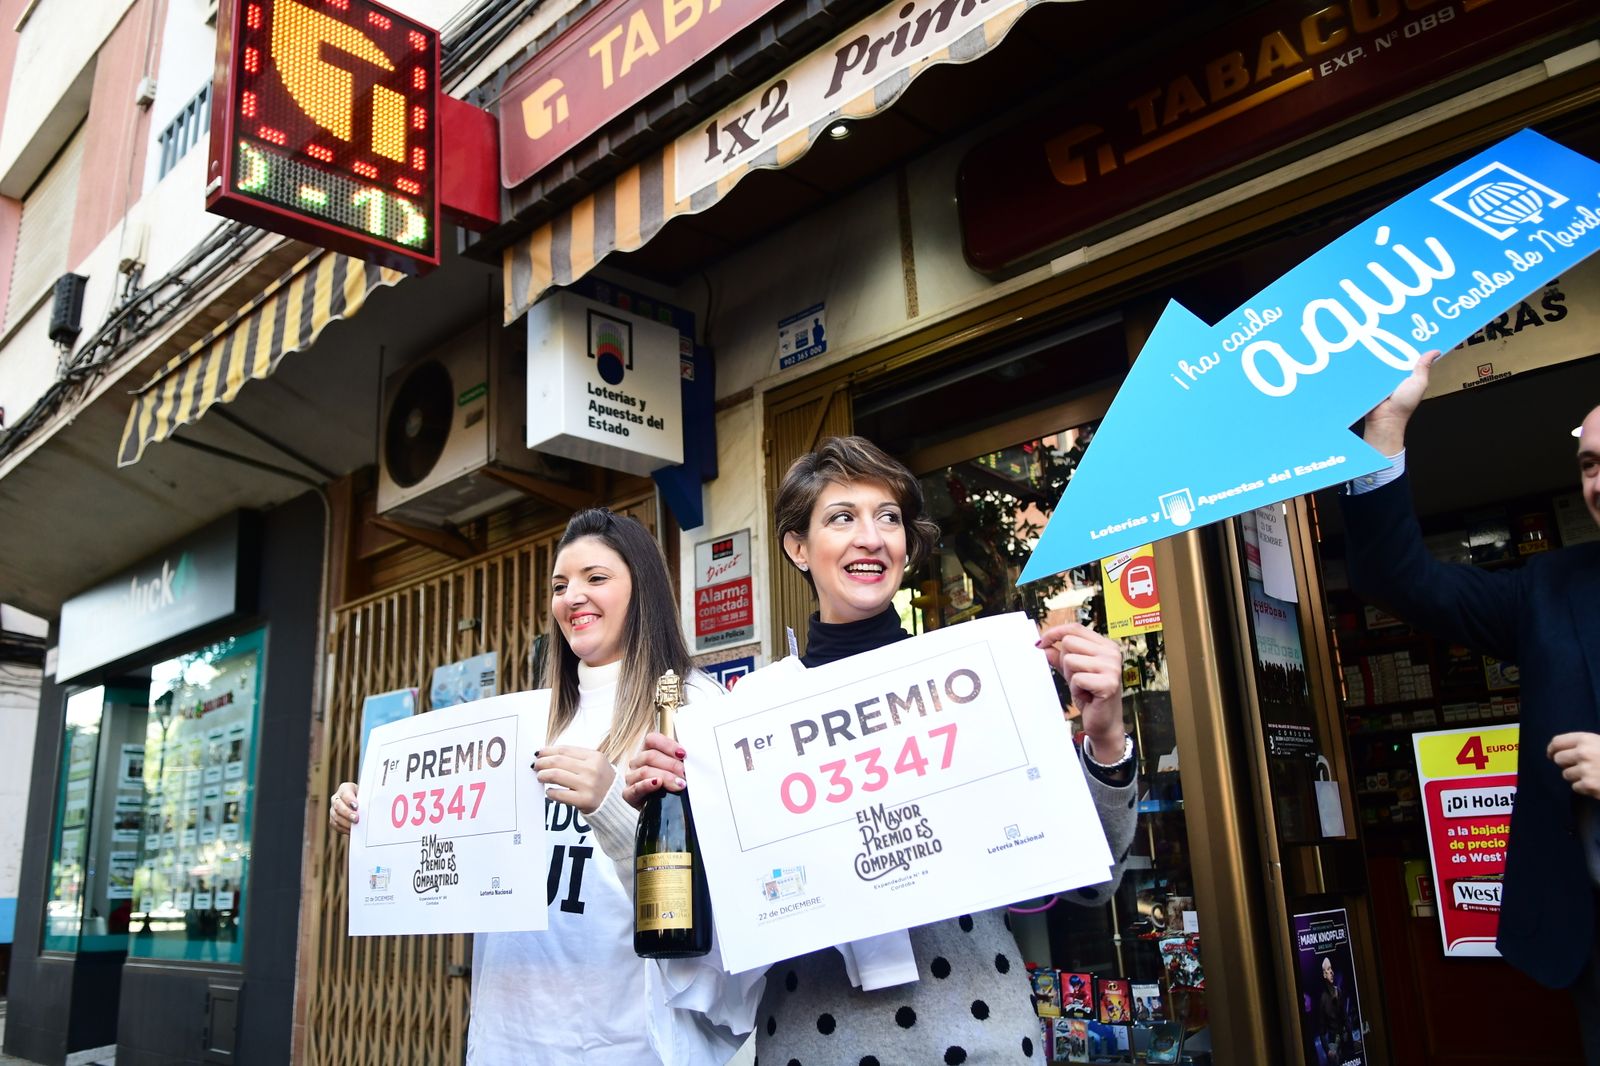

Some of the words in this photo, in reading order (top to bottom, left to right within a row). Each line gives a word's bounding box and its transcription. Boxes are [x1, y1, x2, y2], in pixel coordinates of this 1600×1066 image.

[824, 0, 992, 99] Prim
[1319, 46, 1368, 77] EXP.
[1403, 5, 1456, 39] 089
[1411, 313, 1440, 342] el
[1432, 271, 1515, 319] Gordo
[1504, 249, 1543, 272] de
[1528, 203, 1600, 253] Navid
[1241, 226, 1456, 397] aquí
[1454, 291, 1568, 350] ERAS
[588, 399, 644, 425] Apuestas
[646, 415, 664, 430] del
[639, 399, 646, 412] y
[588, 416, 630, 437] Estado
[1197, 479, 1264, 506] Apuestas
[1268, 469, 1291, 485] del
[1294, 454, 1347, 476] Estado
[1151, 511, 1160, 523] y
[700, 584, 748, 605] Alarma
[699, 596, 749, 618] conectada
[790, 668, 982, 757] PREMIO
[406, 736, 506, 782] PREMIO
[1456, 735, 1489, 770] 4
[1486, 743, 1520, 753] EUROS
[780, 722, 958, 815] 03347
[391, 782, 486, 829] 03347
[1447, 795, 1468, 813] ¡Di
[1472, 792, 1515, 809] Hola!
[856, 809, 871, 824] EL
[422, 836, 428, 847] EL
[1013, 831, 1045, 846] Nacional
[1448, 828, 1455, 837] a
[1458, 826, 1468, 836] la
[1449, 840, 1465, 850] de
[1467, 838, 1506, 851] precio
[1452, 853, 1467, 863] de
[1469, 852, 1501, 863] West
[1458, 885, 1500, 902] West
[758, 912, 767, 921] 22
[769, 909, 779, 918] de
[780, 896, 822, 915] DICIEMBRE
[1300, 933, 1319, 946] MARK
[1318, 929, 1345, 943] KNOPFLER
